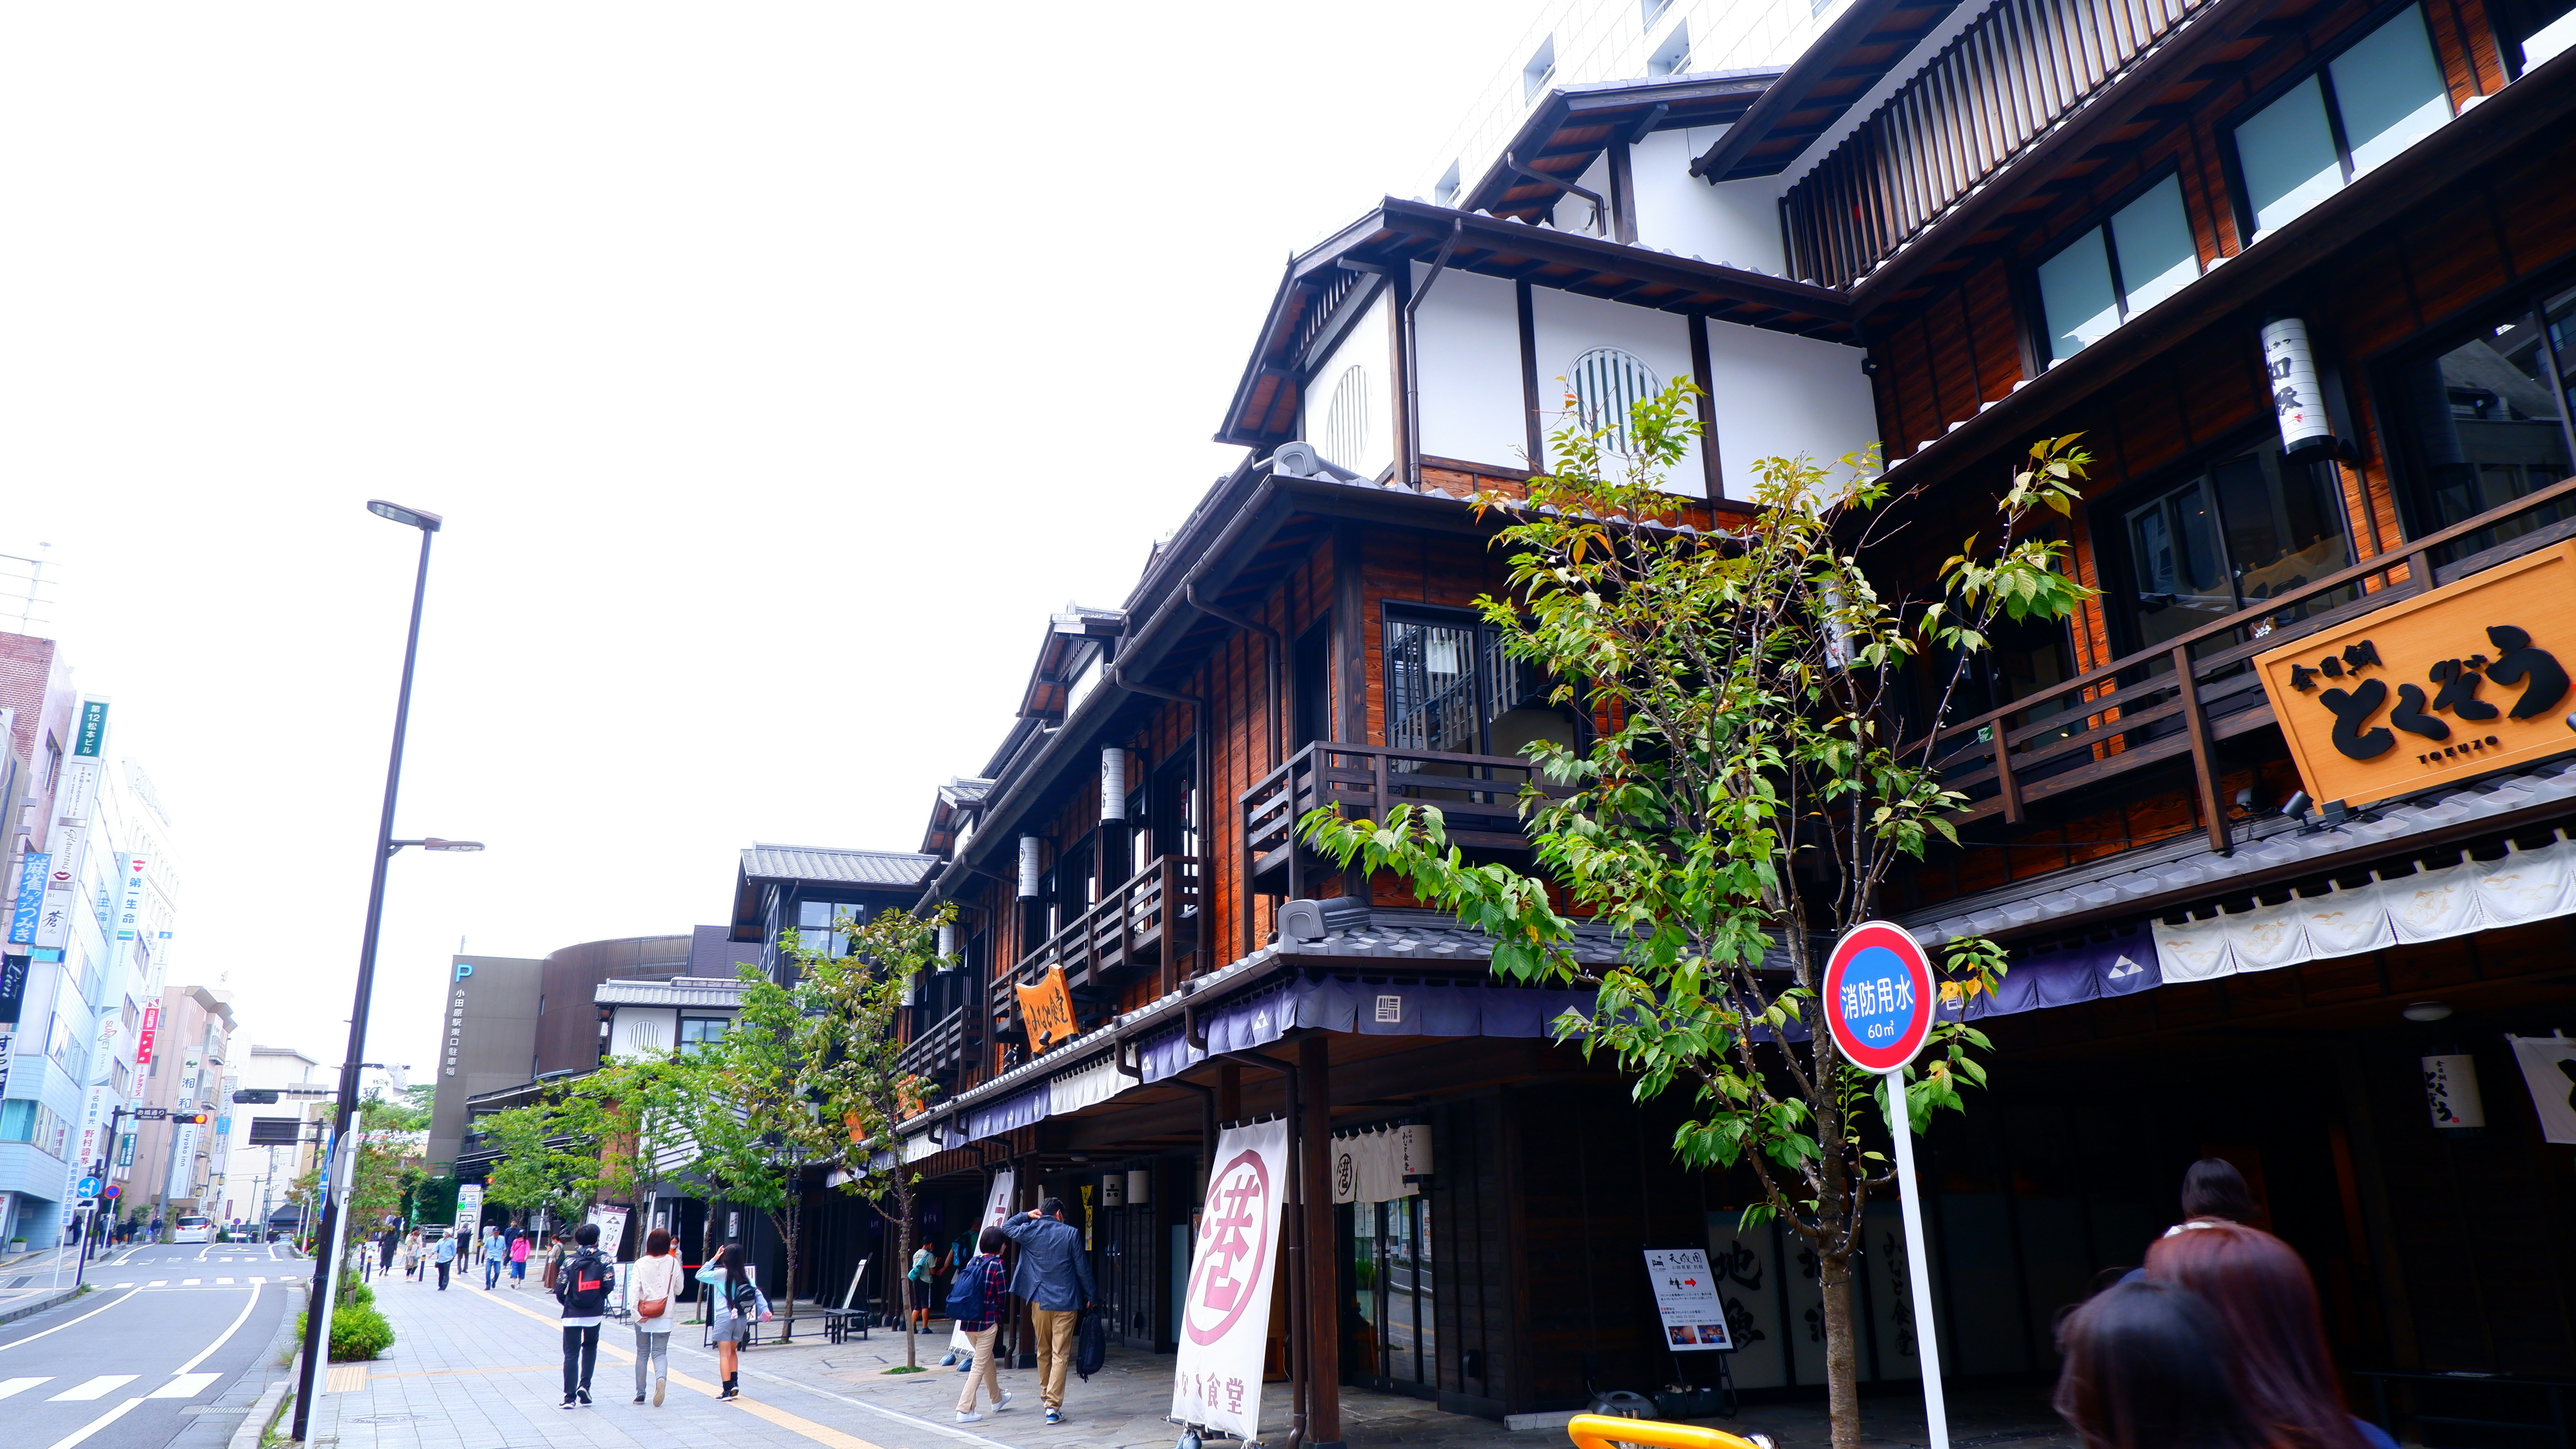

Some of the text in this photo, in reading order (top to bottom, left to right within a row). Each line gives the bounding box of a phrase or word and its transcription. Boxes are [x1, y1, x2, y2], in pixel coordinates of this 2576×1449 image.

[2289, 640, 2382, 692] 金目鯛
[2319, 625, 2570, 760] とくぞう
[82, 705, 101, 754] 第12松本ビル
[2417, 735, 2499, 764] TOKUZO
[23, 860, 47, 891] 麻雀
[122, 877, 142, 923] 第一生命
[14, 907, 37, 942] つみき
[456, 964, 472, 982] P
[1841, 974, 1914, 1020] 消防用水
[445, 989, 466, 1077] 小田原駅東口駐車場
[87, 1095, 100, 1125] 名鉄観光
[178, 1078, 195, 1108] 湘和
[2425, 1071, 2453, 1122] とくぞう
[80, 1130, 95, 1164] 野村證券
[182, 1131, 192, 1154] toyoko
[1339, 1159, 1349, 1188] 港
[1190, 1174, 1260, 1312] 港
